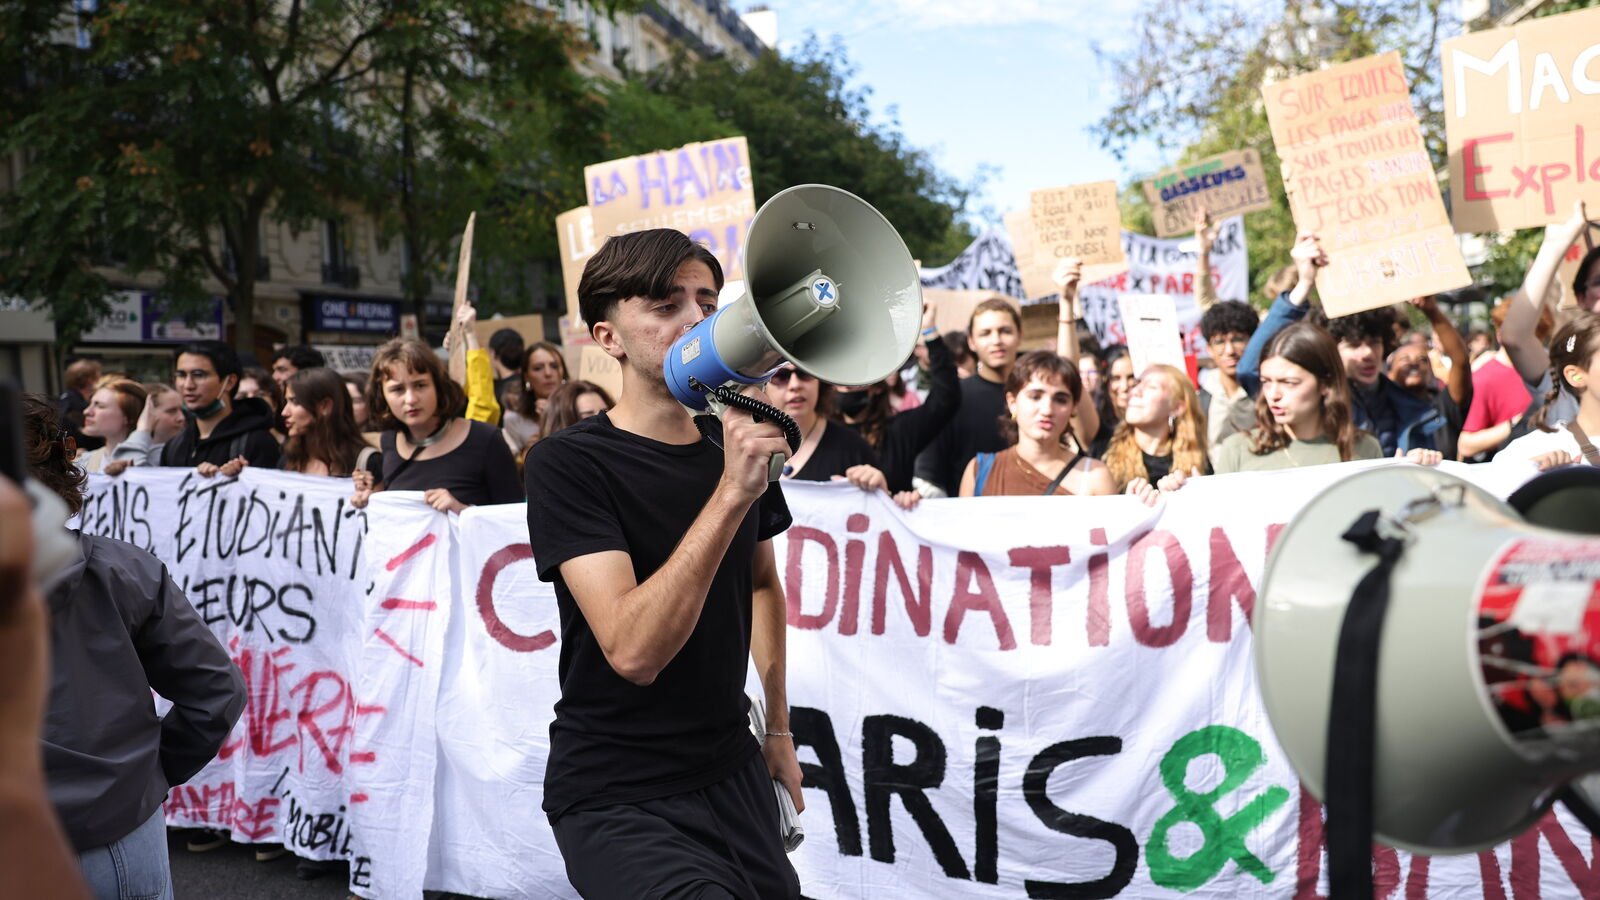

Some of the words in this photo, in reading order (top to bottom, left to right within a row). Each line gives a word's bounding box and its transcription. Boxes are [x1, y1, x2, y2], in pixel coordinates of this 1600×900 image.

[1279, 84, 1333, 121] SUR
[1334, 64, 1408, 103] TOUTES
[1287, 123, 1321, 149] LES
[1328, 107, 1378, 138] PAGES
[1293, 149, 1331, 173] SUR
[1335, 131, 1394, 161] TOUTES
[1397, 126, 1421, 149] LES
[1297, 165, 1366, 203] PAGES
[1391, 178, 1435, 209] TON
[1150, 265, 1223, 295] PARS
